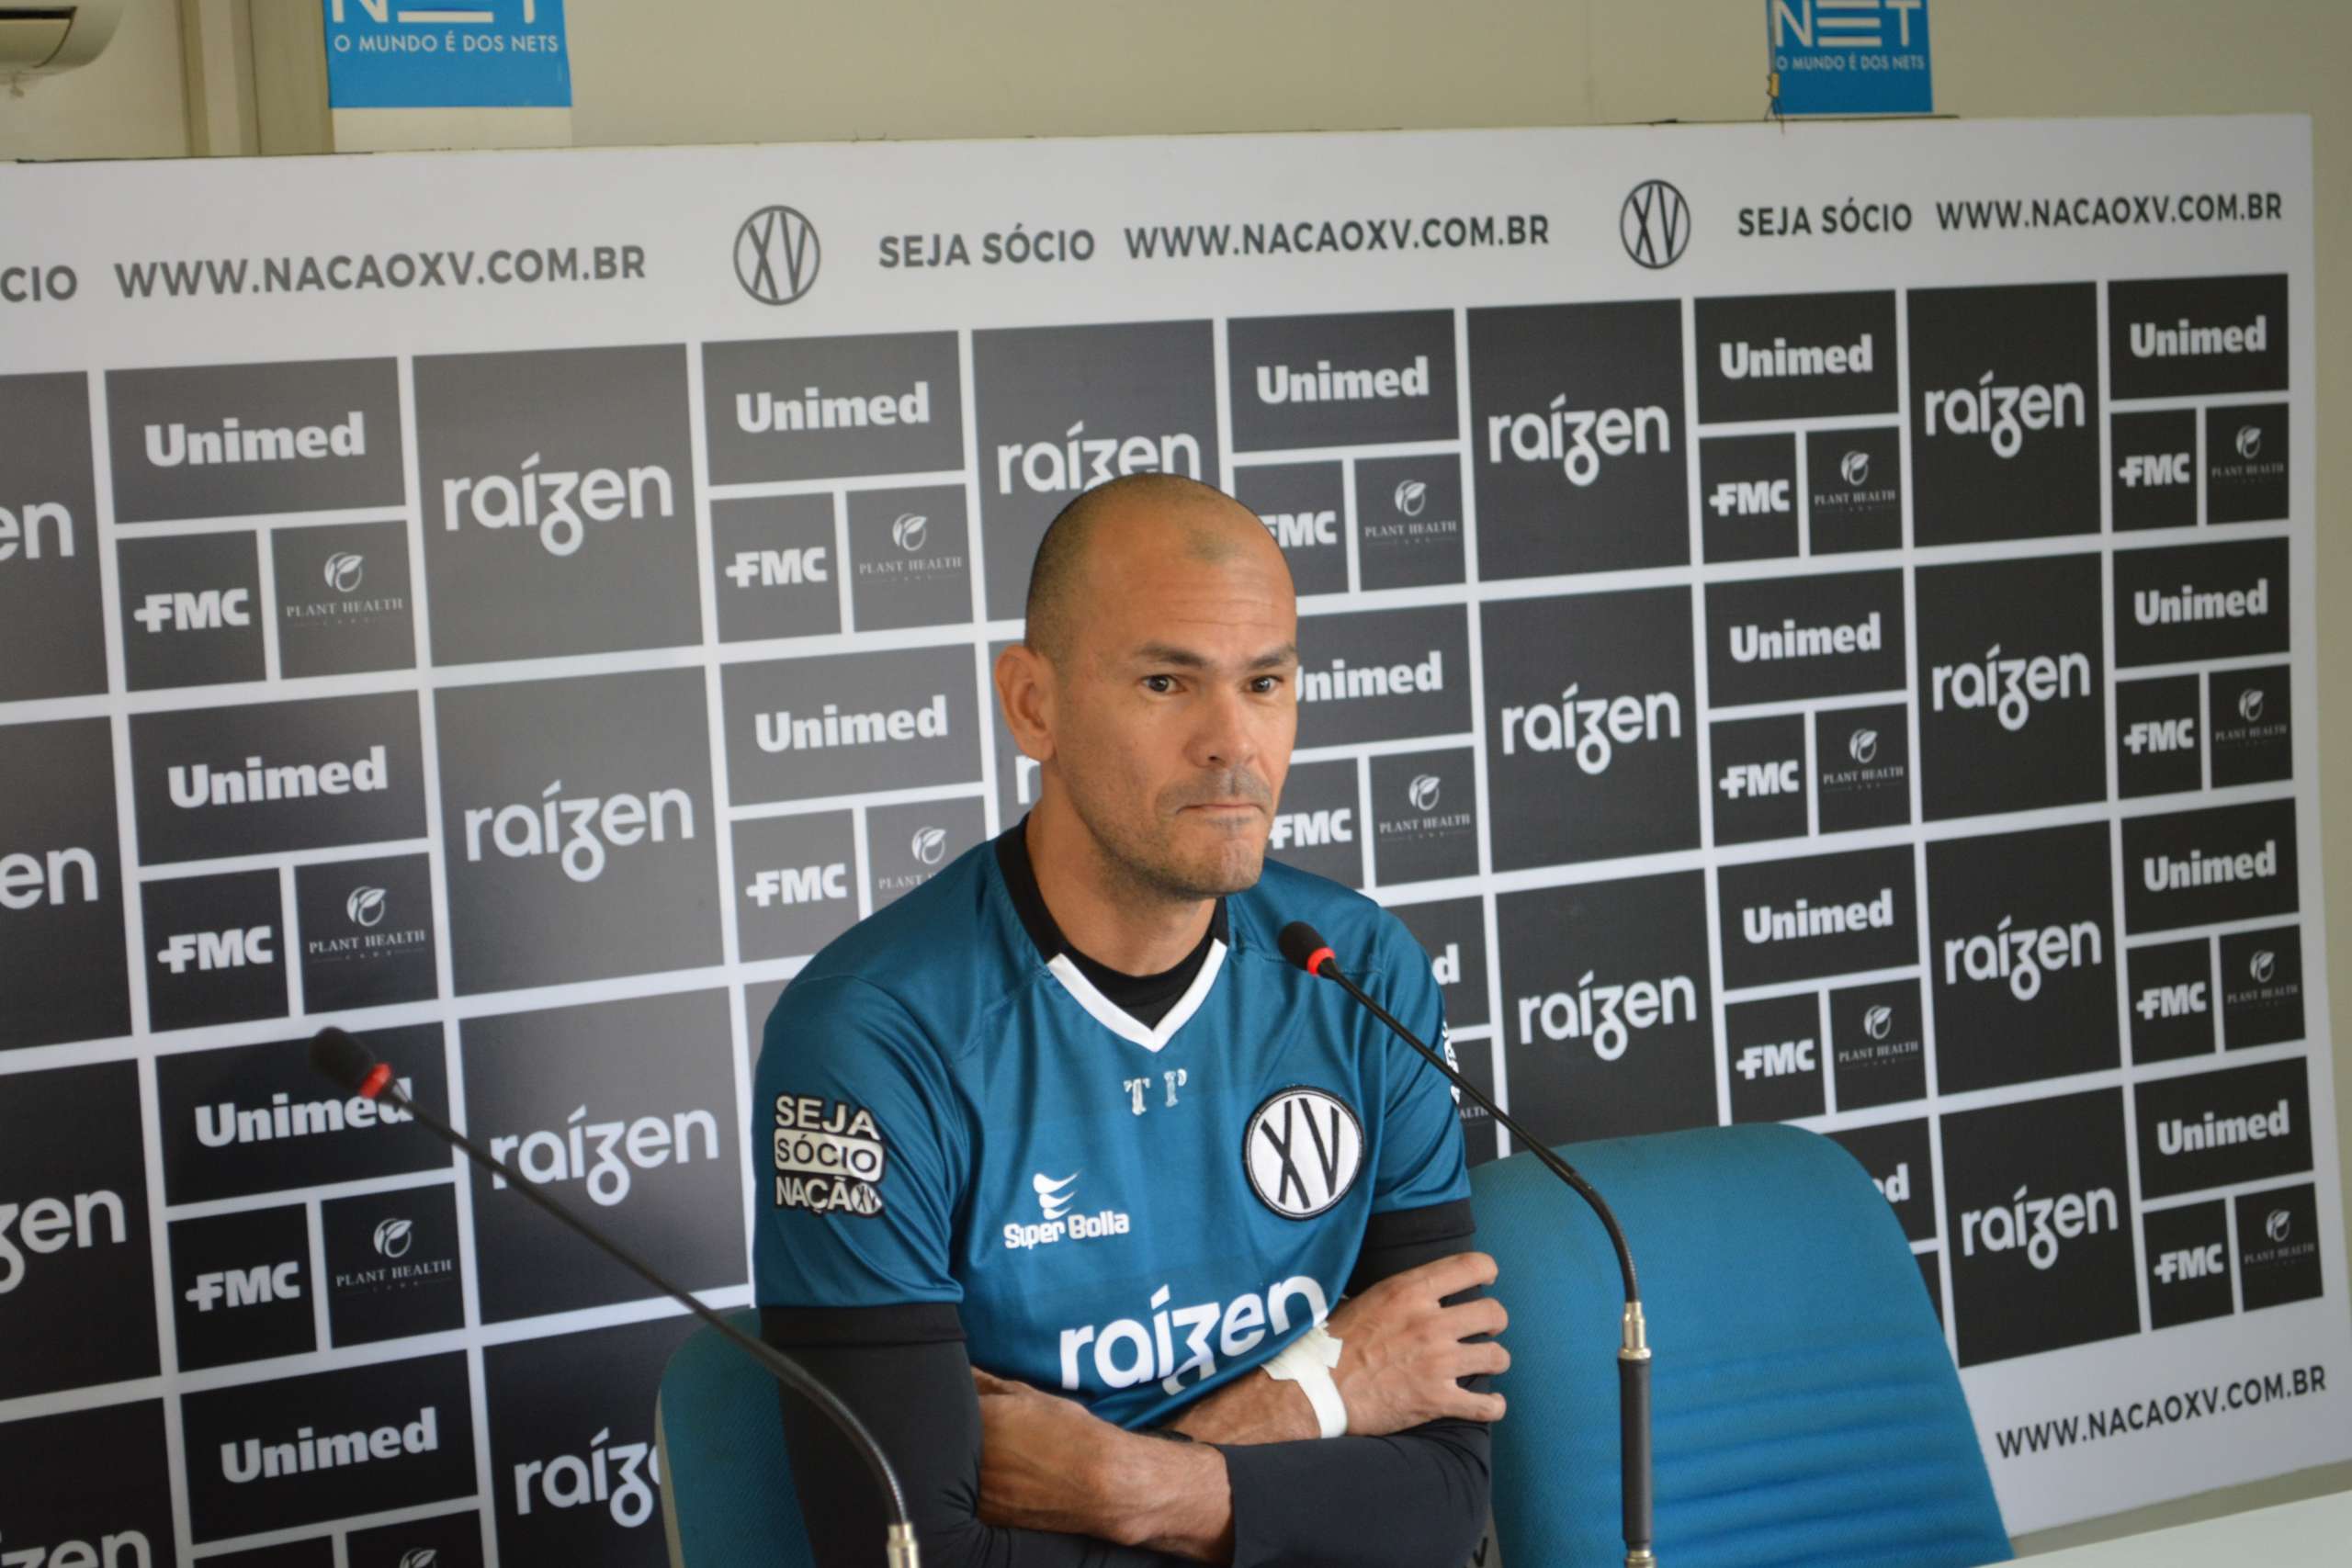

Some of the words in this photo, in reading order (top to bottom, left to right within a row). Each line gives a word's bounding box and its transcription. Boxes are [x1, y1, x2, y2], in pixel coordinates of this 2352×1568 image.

[334, 34, 351, 52] O
[359, 34, 437, 52] MUNDO
[445, 30, 456, 52] É
[463, 34, 504, 52] DOS
[511, 34, 559, 52] NETS
[1792, 55, 1845, 70] MUNDO
[1861, 55, 1888, 70] DOS
[1893, 54, 1925, 70] NETS
[1630, 184, 1680, 265] XV
[1738, 207, 1812, 236] SEJA
[1822, 197, 1912, 233] SÓCIO
[1936, 192, 2281, 230] WWW.NACAOXV.COM.BR
[747, 210, 809, 300] XV
[879, 234, 970, 268] SEJA
[982, 223, 1094, 265] SÓCIO
[1125, 214, 1548, 258] WWW.NACAOXV.COM.BR
[0, 265, 77, 302] CIO
[114, 245, 645, 299] WWW.NACAOXV.COM.BR
[1720, 334, 1872, 378] Unimed
[2131, 315, 2266, 357] Unimed
[1257, 356, 1429, 404] Unimed
[736, 382, 930, 433] Unimed
[1925, 371, 2085, 457] raízen
[145, 412, 366, 467] Unimed
[1488, 394, 1669, 486] raízen
[2119, 453, 2189, 487] FMC
[443, 453, 673, 556] raízen
[1709, 479, 1790, 515] FMC
[1815, 492, 1849, 505] PLANT
[1853, 491, 1895, 502] HEALTH
[1364, 525, 1404, 537] PLANT
[1408, 521, 1456, 535] HEALTH
[726, 547, 827, 587] FMC
[860, 561, 903, 574] PLANT
[909, 557, 961, 570] HEALTH
[134, 588, 250, 632] FMC
[287, 603, 337, 617] PLANT
[343, 598, 403, 613] HEALTH
[2135, 579, 2267, 625] Unimed
[1730, 613, 1881, 662] Unimed
[1932, 644, 2090, 730] raízen
[755, 694, 947, 752] Unimed
[1502, 683, 1680, 774] raízen
[2124, 718, 2194, 754] FMC
[168, 745, 388, 807] Unimed
[1720, 761, 1799, 798] FMC
[1823, 772, 1857, 784] PLANT
[1861, 766, 1904, 780] HEALTH
[465, 780, 695, 882] raízen
[1269, 808, 1352, 849] FMC
[1379, 819, 1419, 833] PLANT
[1423, 814, 1470, 829] HEALTH
[746, 863, 847, 907] FMC
[2143, 840, 2276, 891] Unimed
[1743, 888, 1893, 943] Unimed
[157, 926, 273, 973] FMC
[310, 937, 359, 953] PLANT
[365, 930, 425, 947] HEALTH
[1945, 916, 2101, 1000] raízen
[1519, 971, 1696, 1061] raízen
[2136, 982, 2206, 1020] FMC
[1736, 1039, 1815, 1079] FMC
[1838, 1047, 1872, 1062] PLANT
[1877, 1041, 1918, 1056] HEALTH
[775, 1095, 881, 1140] SEJA
[2157, 1100, 2290, 1155] Unimed
[490, 1106, 718, 1206] raízen
[777, 1134, 876, 1173] SÓCIO
[1260, 1097, 1341, 1210] XV
[1004, 1219, 1065, 1250] Super
[1069, 1210, 1130, 1239] Bolla
[1962, 1186, 2118, 1269] raízen
[186, 1261, 300, 1311] FMC
[336, 1269, 385, 1287] PLANT
[392, 1259, 451, 1279] HEALTH
[2154, 1244, 2223, 1283] FMC
[1060, 1275, 1329, 1396] raízen
[1996, 1364, 2326, 1459] WWW.NACAOXV.COM.BR
[221, 1406, 437, 1483] Unimed
[514, 1427, 661, 1529] raíz
